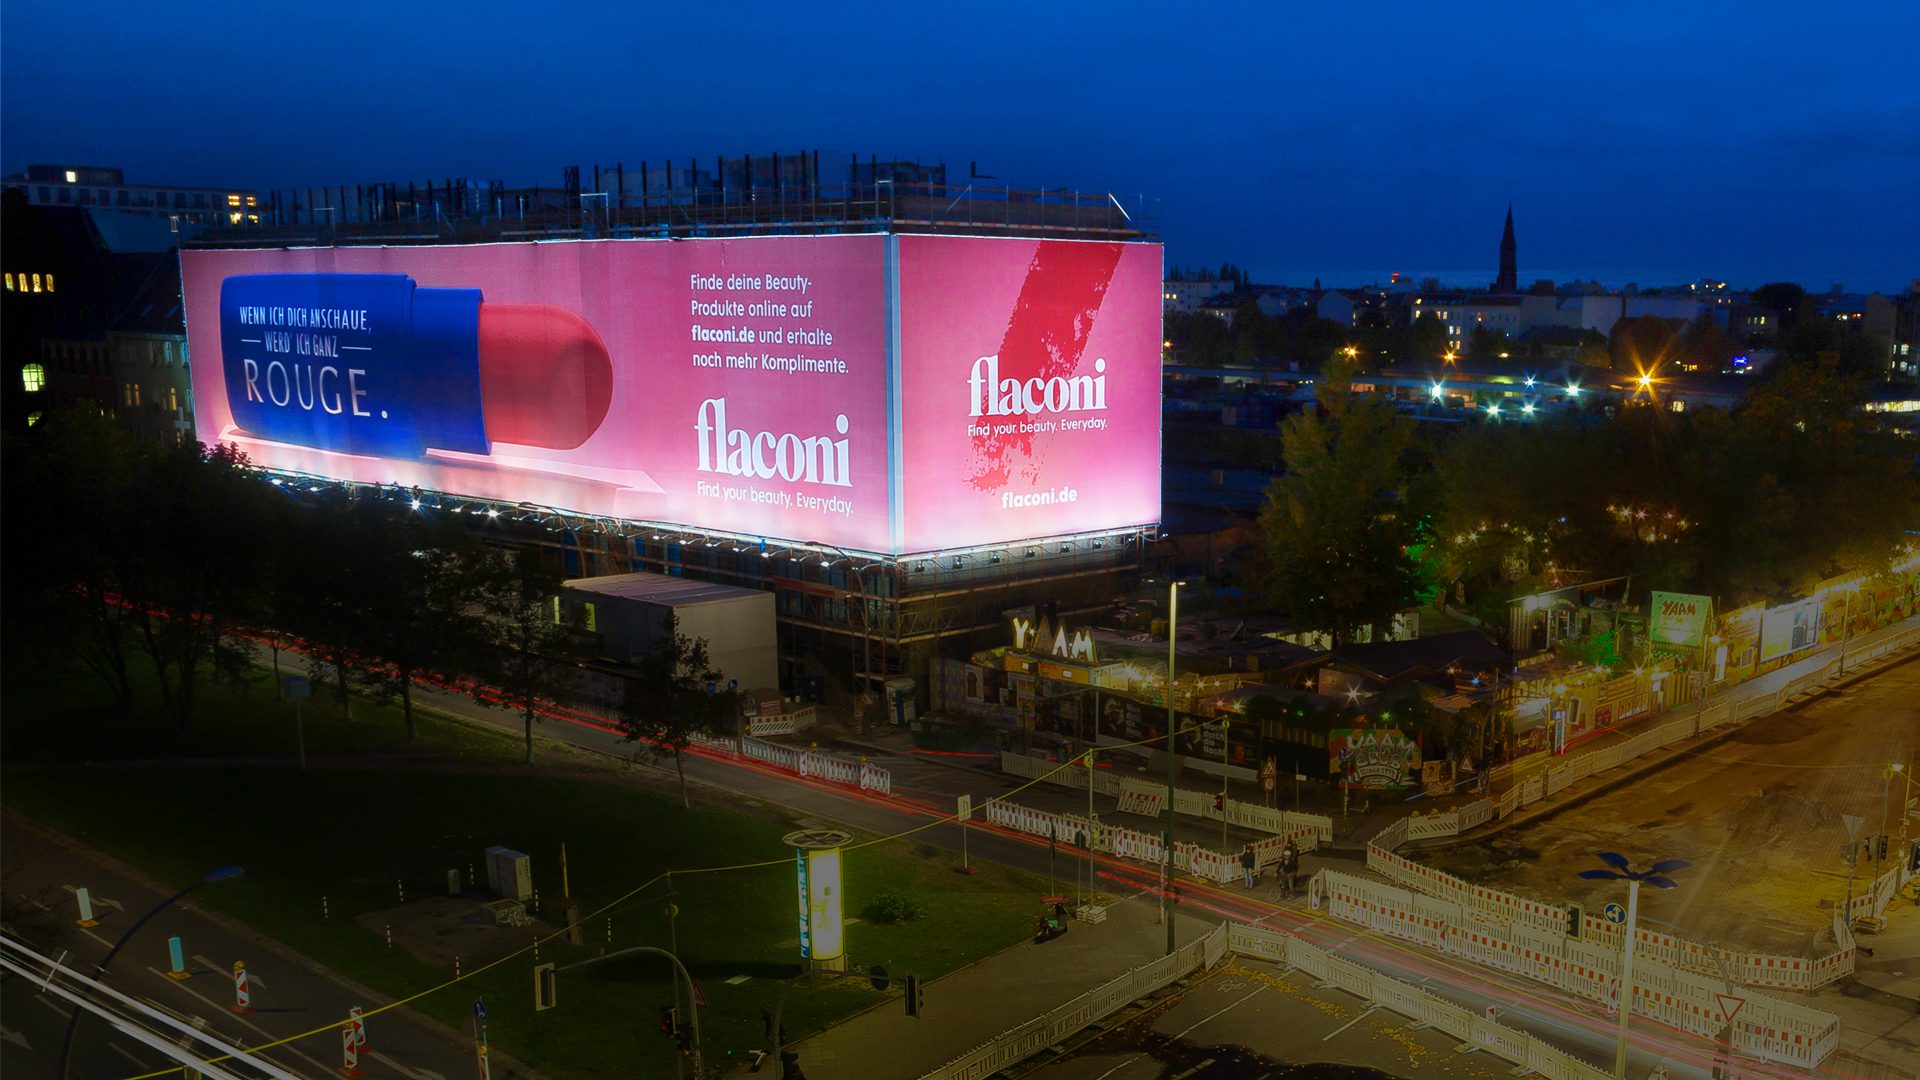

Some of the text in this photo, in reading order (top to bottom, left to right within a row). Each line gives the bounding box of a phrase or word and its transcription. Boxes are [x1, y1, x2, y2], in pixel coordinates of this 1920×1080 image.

[691, 274, 812, 294] Finde deine Beauty-
[239, 306, 372, 335] WENN ICH DICH ANSCHAUE,
[691, 300, 813, 318] Produkte online auf
[264, 331, 339, 357] WERD' ICH GANZ
[691, 325, 833, 346] flaconi.de und erhalte
[692, 352, 849, 375] noch mehr Komplimente.
[243, 358, 389, 420] ROUGE.
[967, 354, 1107, 417] flaconi
[968, 417, 1108, 437] Find your beauty. Everyday.
[694, 397, 853, 487] flaconi
[697, 481, 854, 517] Find your beauty. Everyday.
[1001, 486, 1078, 509] flaconi.de
[1011, 612, 1098, 664] YAAM
